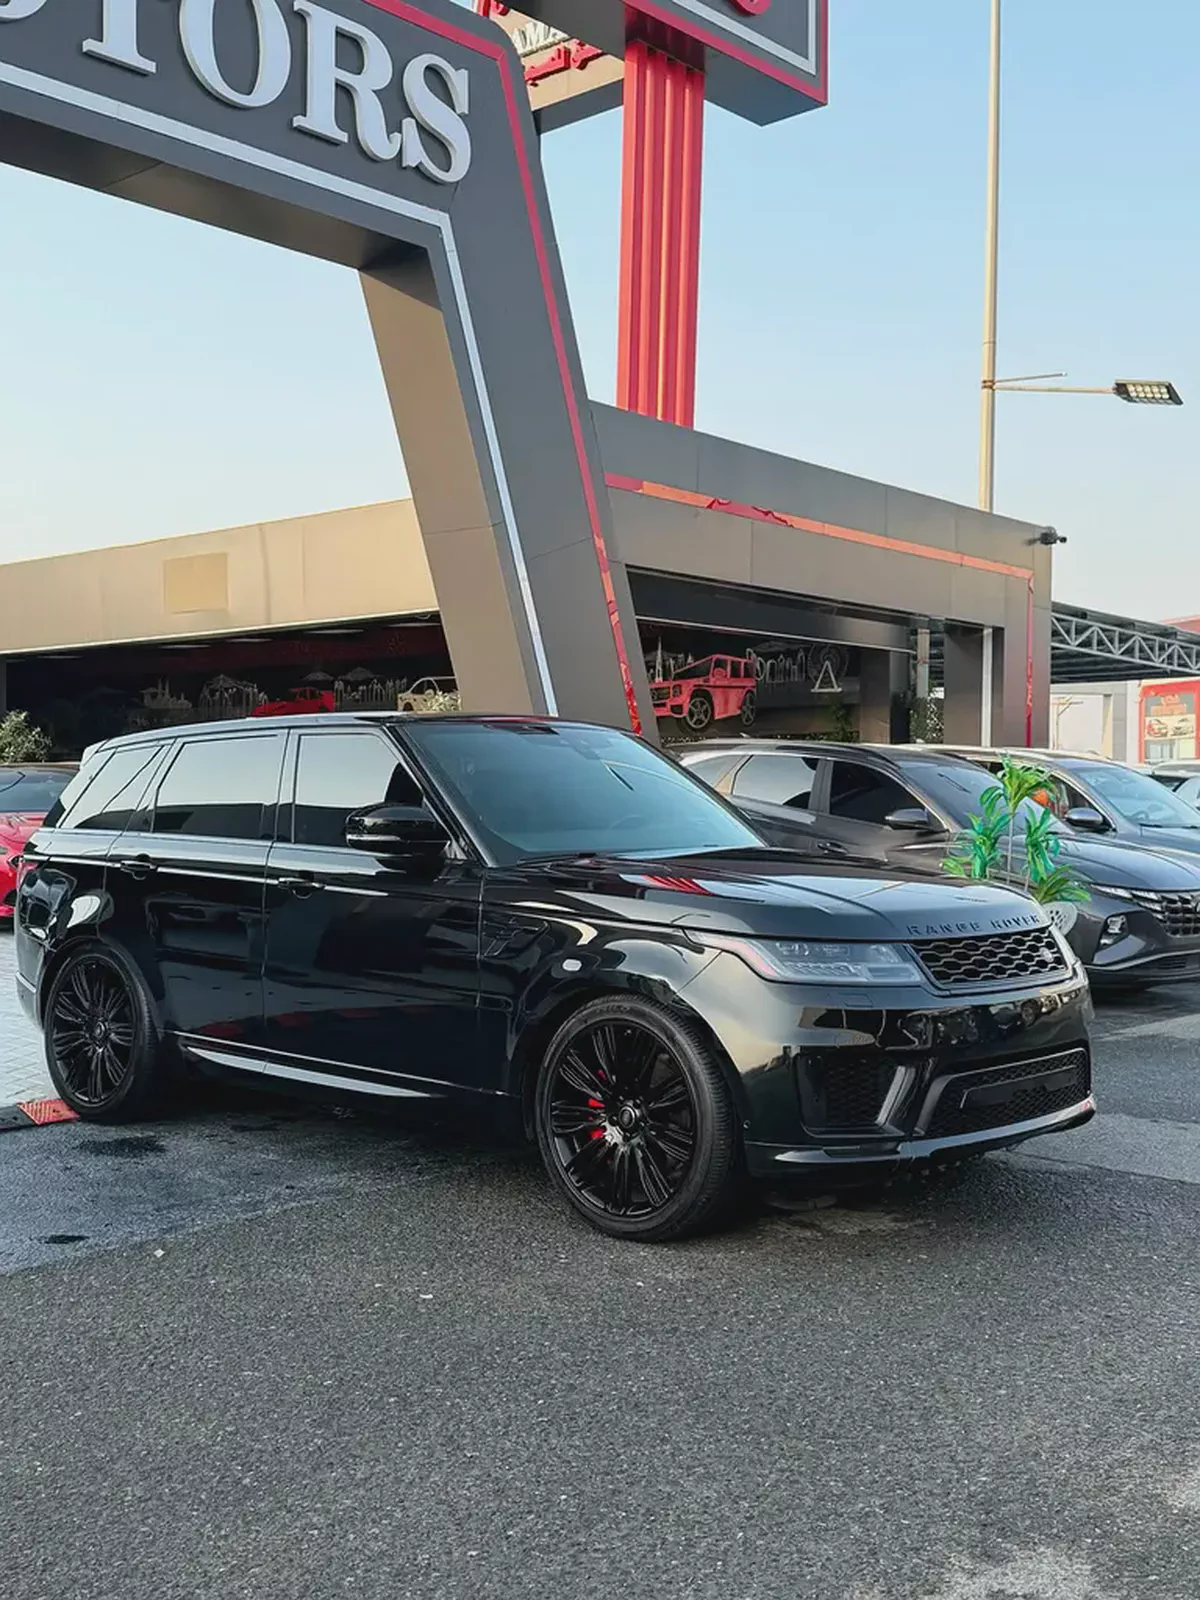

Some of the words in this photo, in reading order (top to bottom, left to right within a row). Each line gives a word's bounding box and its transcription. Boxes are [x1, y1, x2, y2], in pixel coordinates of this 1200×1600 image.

[0, 0, 471, 183] ORS
[906, 921, 981, 936] RANGE
[990, 913, 1041, 931] ROVER
